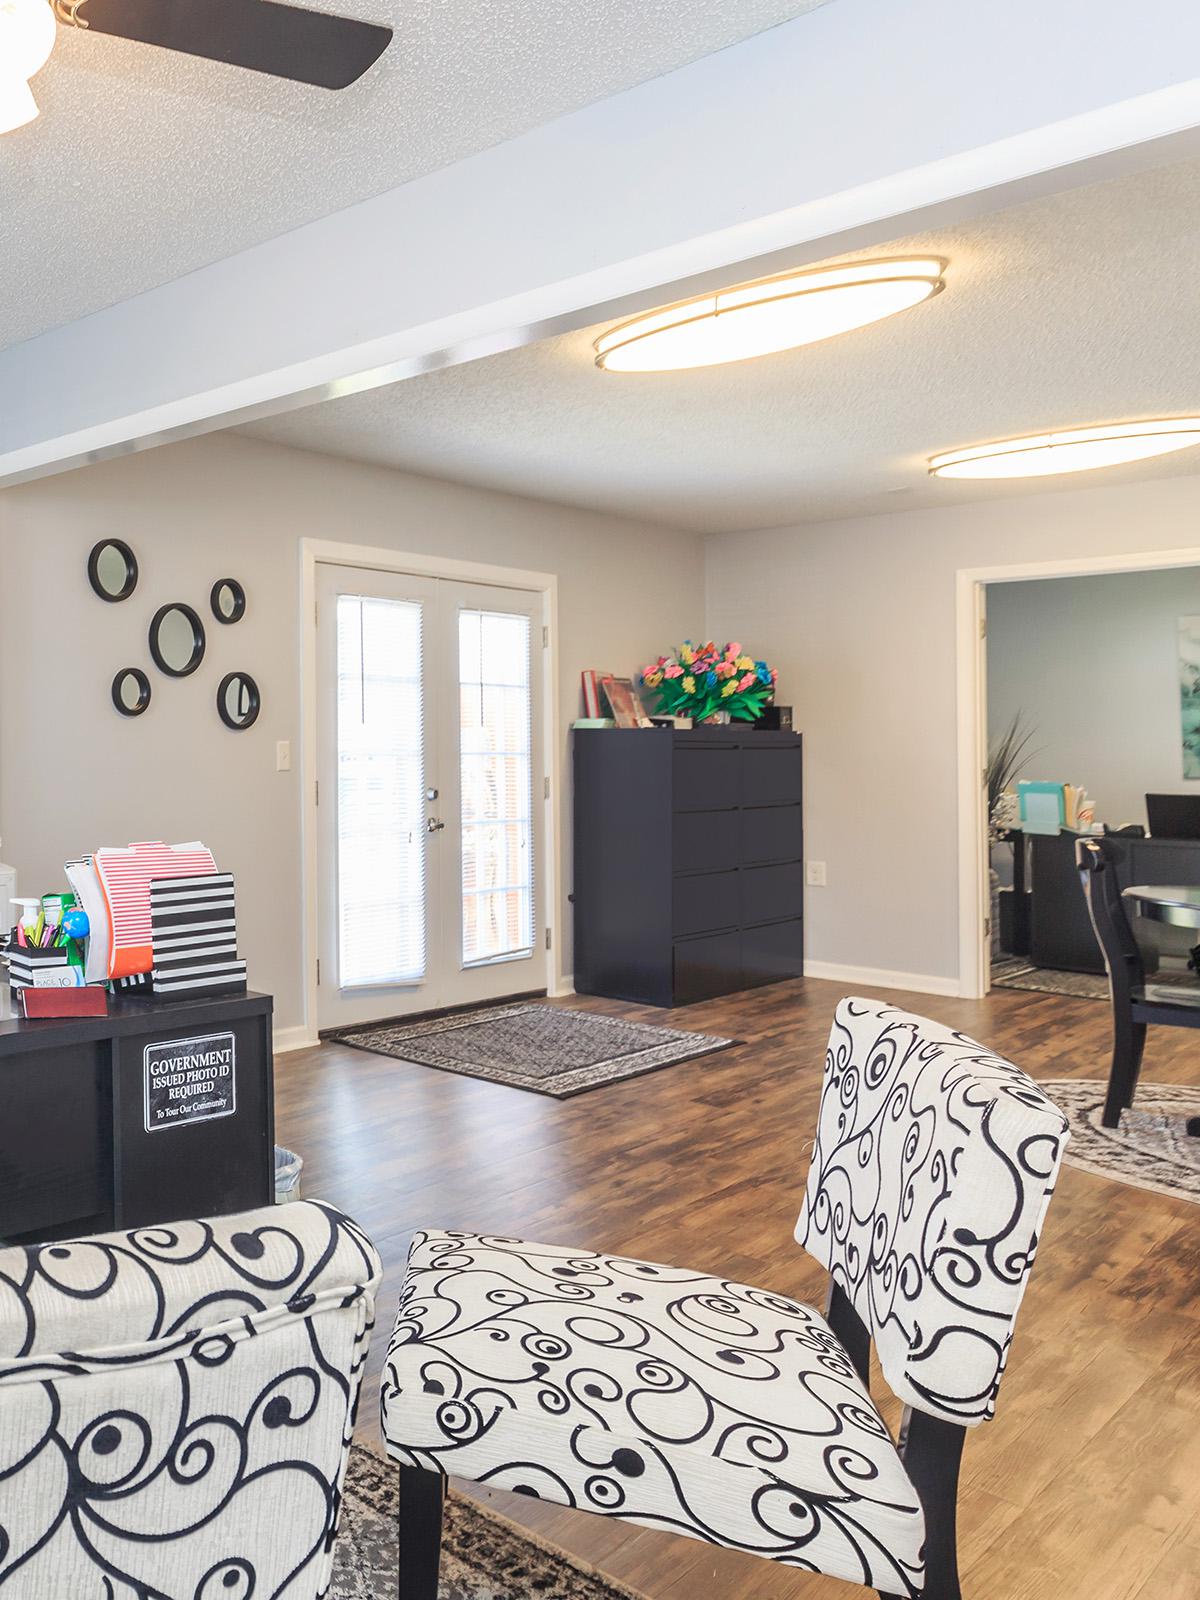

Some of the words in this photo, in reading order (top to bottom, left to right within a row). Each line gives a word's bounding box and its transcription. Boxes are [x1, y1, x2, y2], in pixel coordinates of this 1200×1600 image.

[151, 1049, 231, 1076] GOVERNMENT
[153, 1073, 185, 1089] ISSUED
[186, 1068, 218, 1082] PHOTO
[219, 1065, 229, 1076] ID
[169, 1082, 214, 1099] REQUIRED
[156, 1110, 164, 1118] To
[165, 1107, 179, 1117] Tour
[180, 1105, 192, 1113] Our
[193, 1098, 227, 1111] Community
